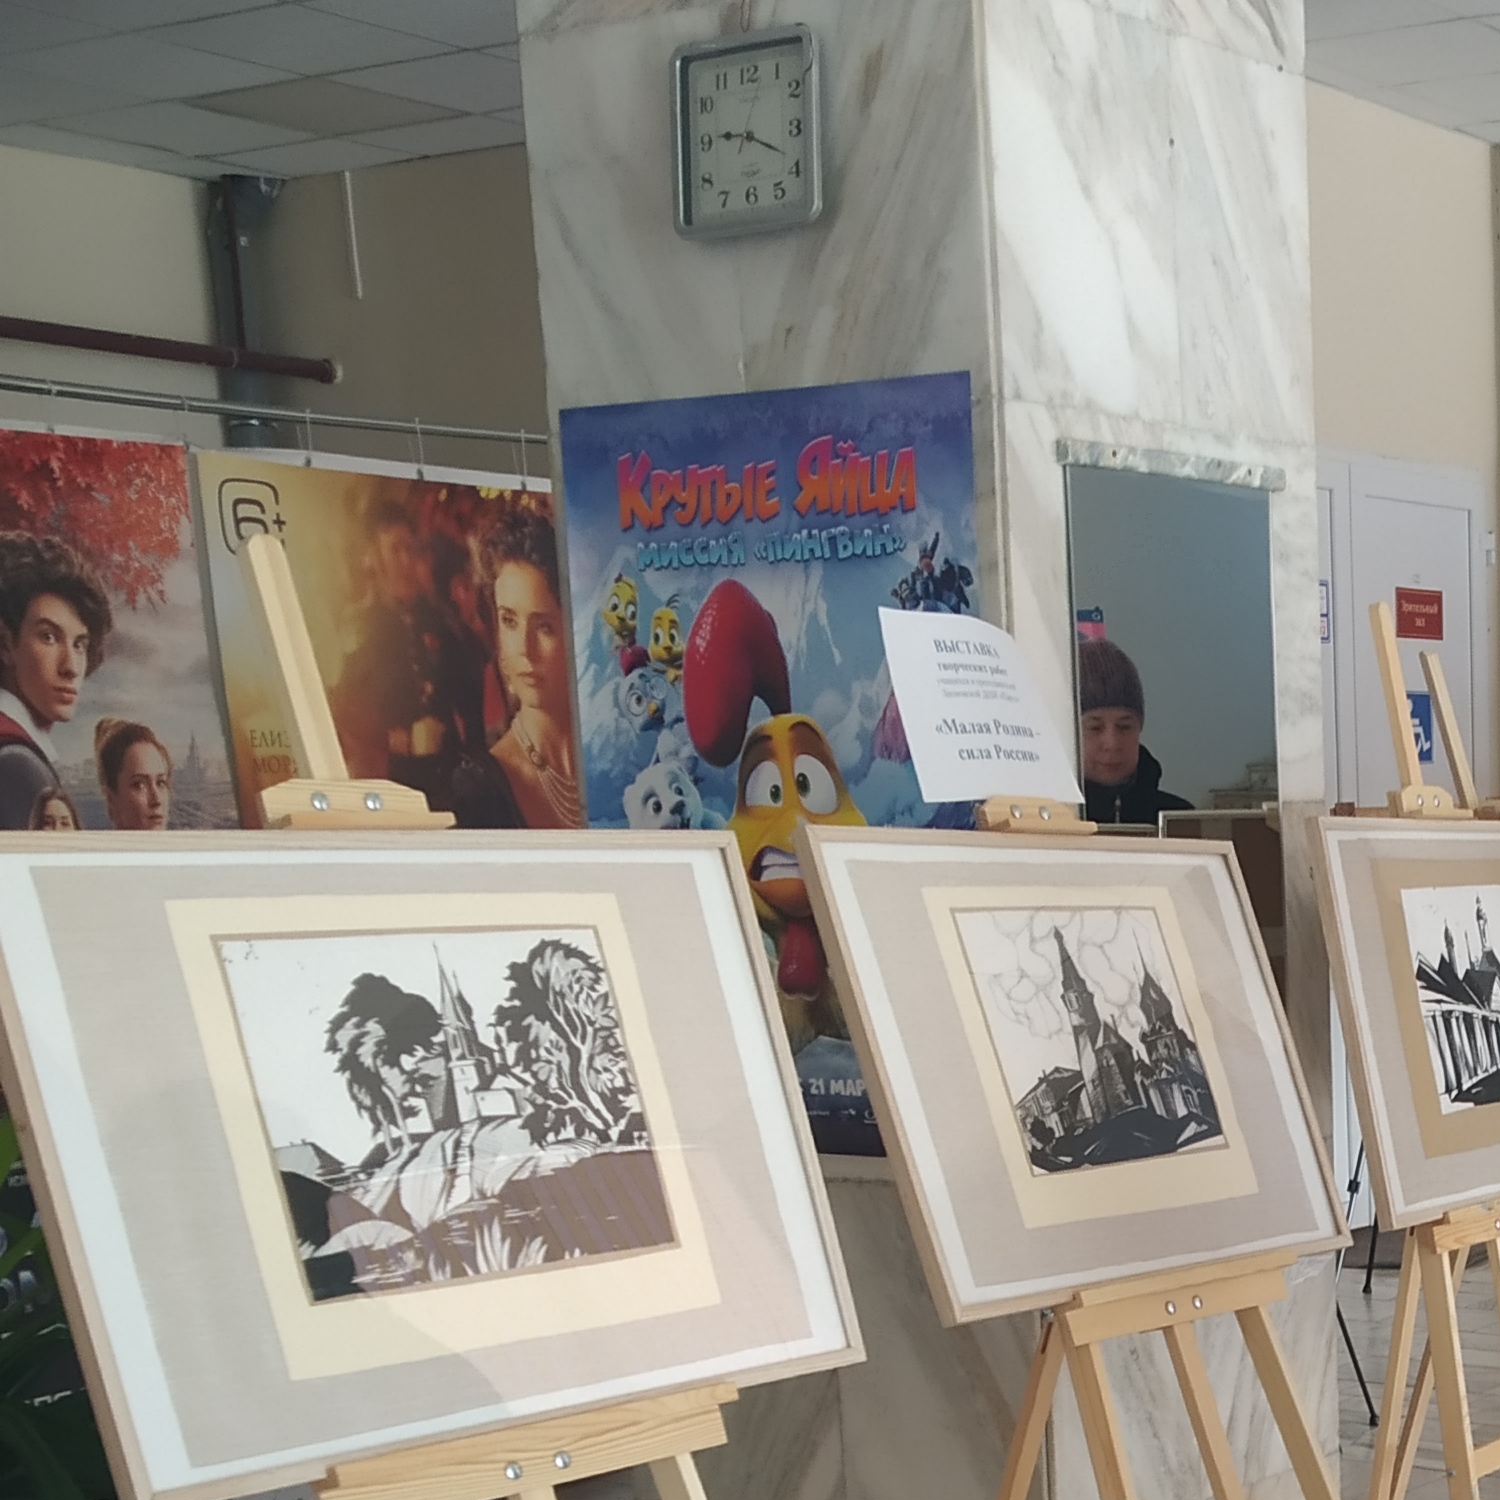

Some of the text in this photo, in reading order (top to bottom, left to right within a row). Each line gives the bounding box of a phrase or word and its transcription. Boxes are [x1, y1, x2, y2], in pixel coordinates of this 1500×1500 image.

[740, 65, 759, 85] 12
[773, 63, 780, 80] 1
[715, 72, 728, 91] 11
[787, 79, 801, 98] 2
[700, 97, 714, 114] 10
[788, 118, 802, 138] 3
[700, 133, 713, 152] 9
[787, 158, 801, 178] 4
[701, 172, 714, 191] 8
[772, 180, 786, 200] 5
[717, 190, 730, 208] 7
[744, 185, 759, 205] 6
[637, 524, 906, 572] МИССИЯ «ПИНГВИН»
[933, 638, 1000, 660] ВЫСТАВКА
[935, 718, 991, 736] «Малая
[993, 719, 1034, 739] Родина
[958, 744, 1041, 763] сила России»
[808, 1078, 867, 1097] 21 МАР
